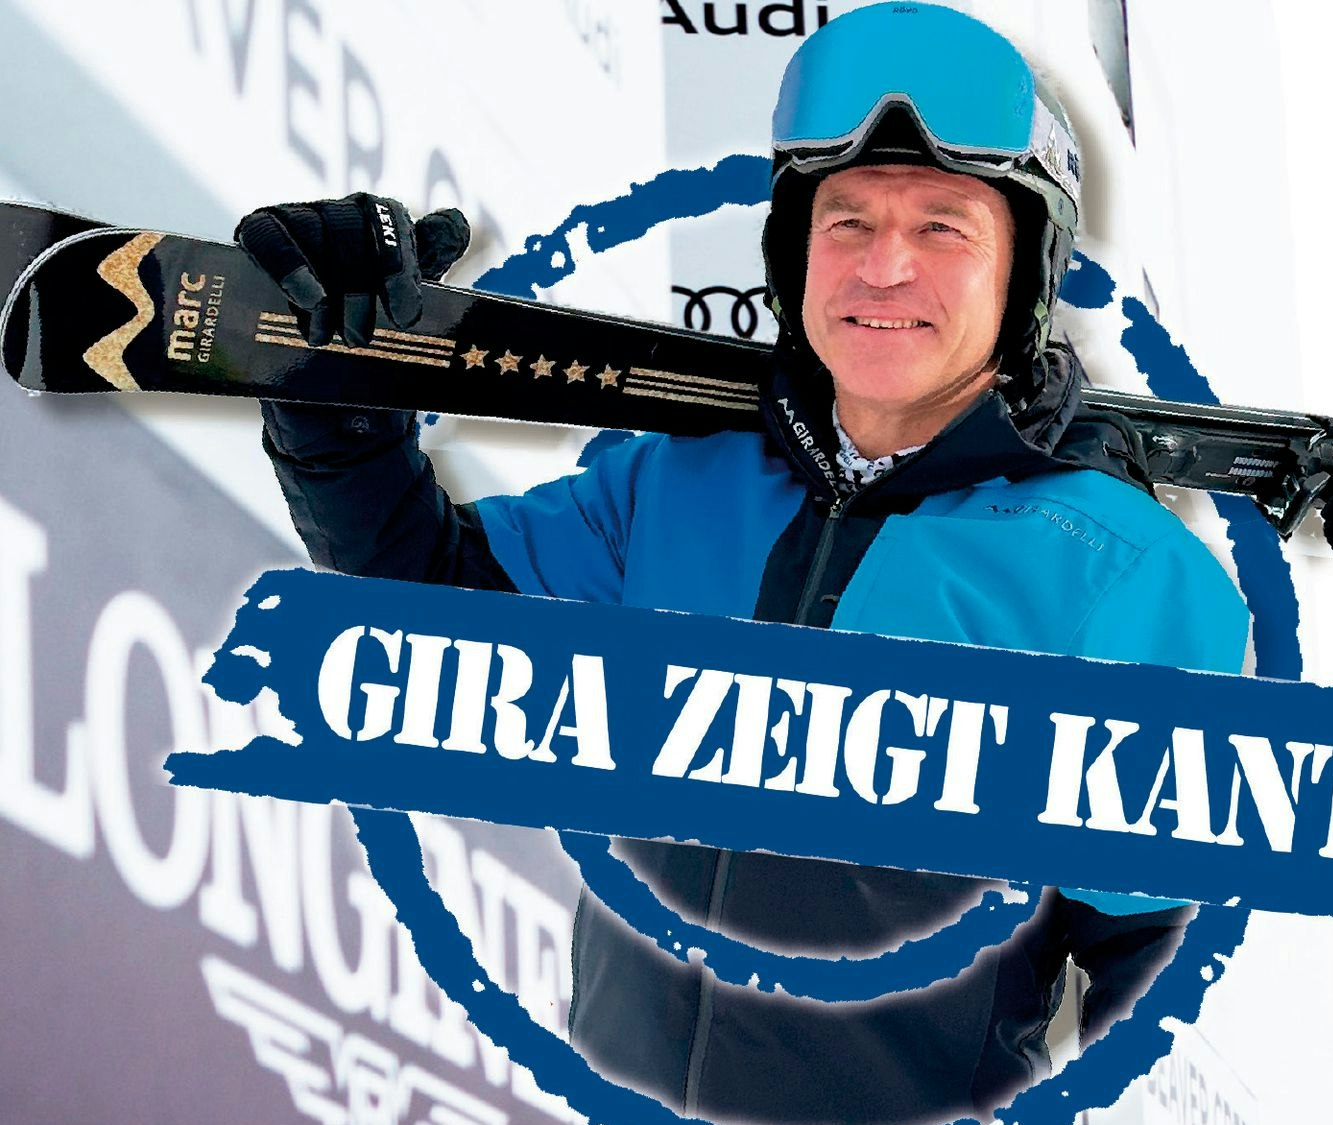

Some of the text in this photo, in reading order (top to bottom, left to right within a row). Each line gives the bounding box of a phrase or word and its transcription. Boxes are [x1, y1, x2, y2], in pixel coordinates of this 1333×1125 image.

[375, 203, 398, 248] LEKI
[167, 271, 207, 362] marc
[197, 274, 226, 363] GIRARDELLI
